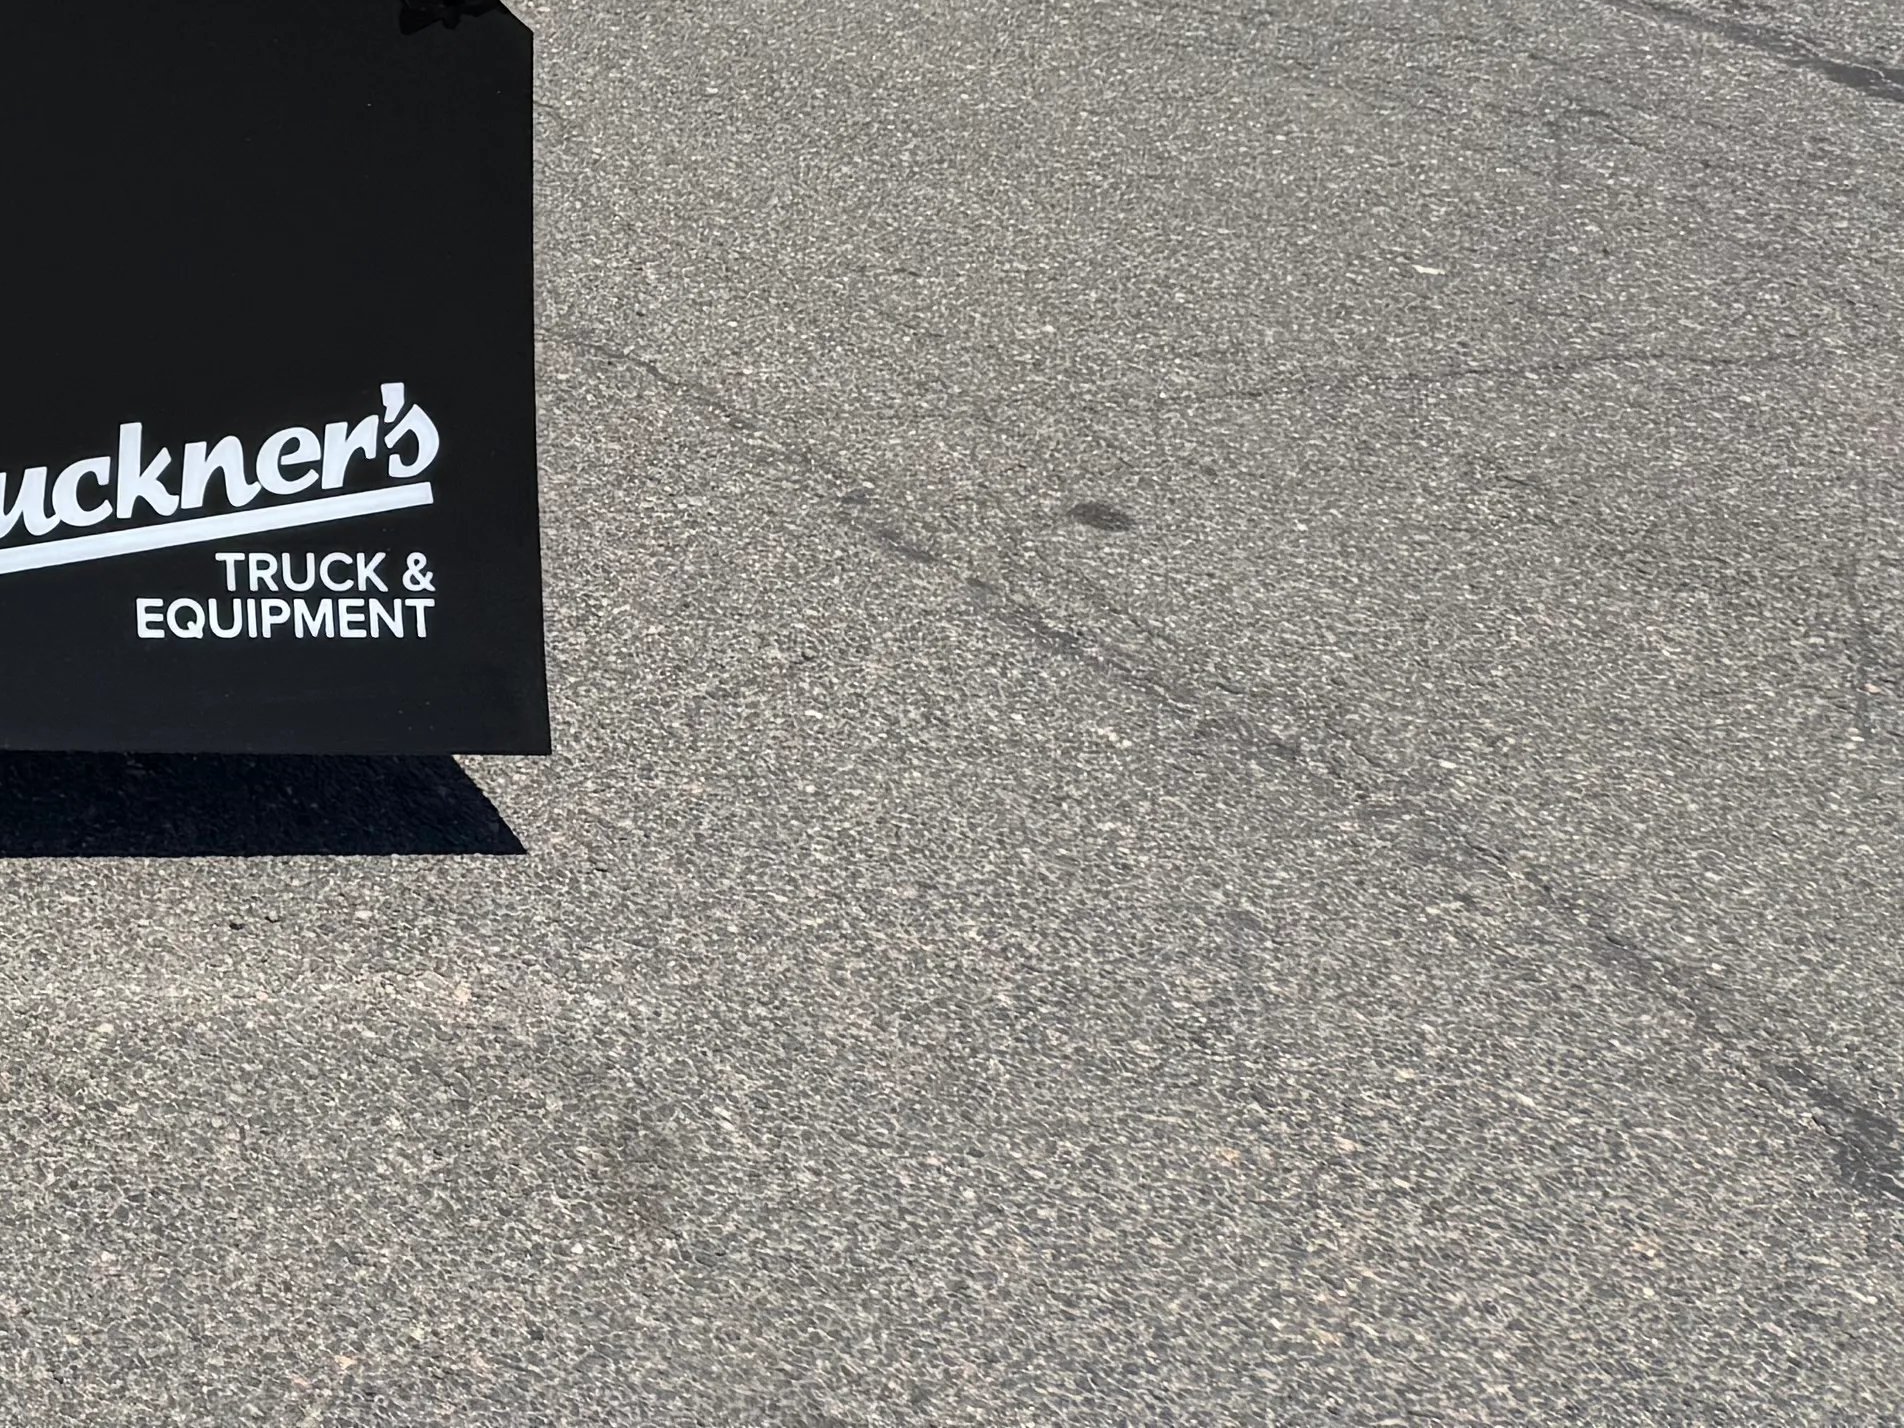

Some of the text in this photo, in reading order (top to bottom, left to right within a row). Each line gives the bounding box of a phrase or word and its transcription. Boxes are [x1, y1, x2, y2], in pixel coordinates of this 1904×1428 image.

[214, 551, 436, 593] TRUCK &
[135, 597, 436, 639] EQUIPMENT
